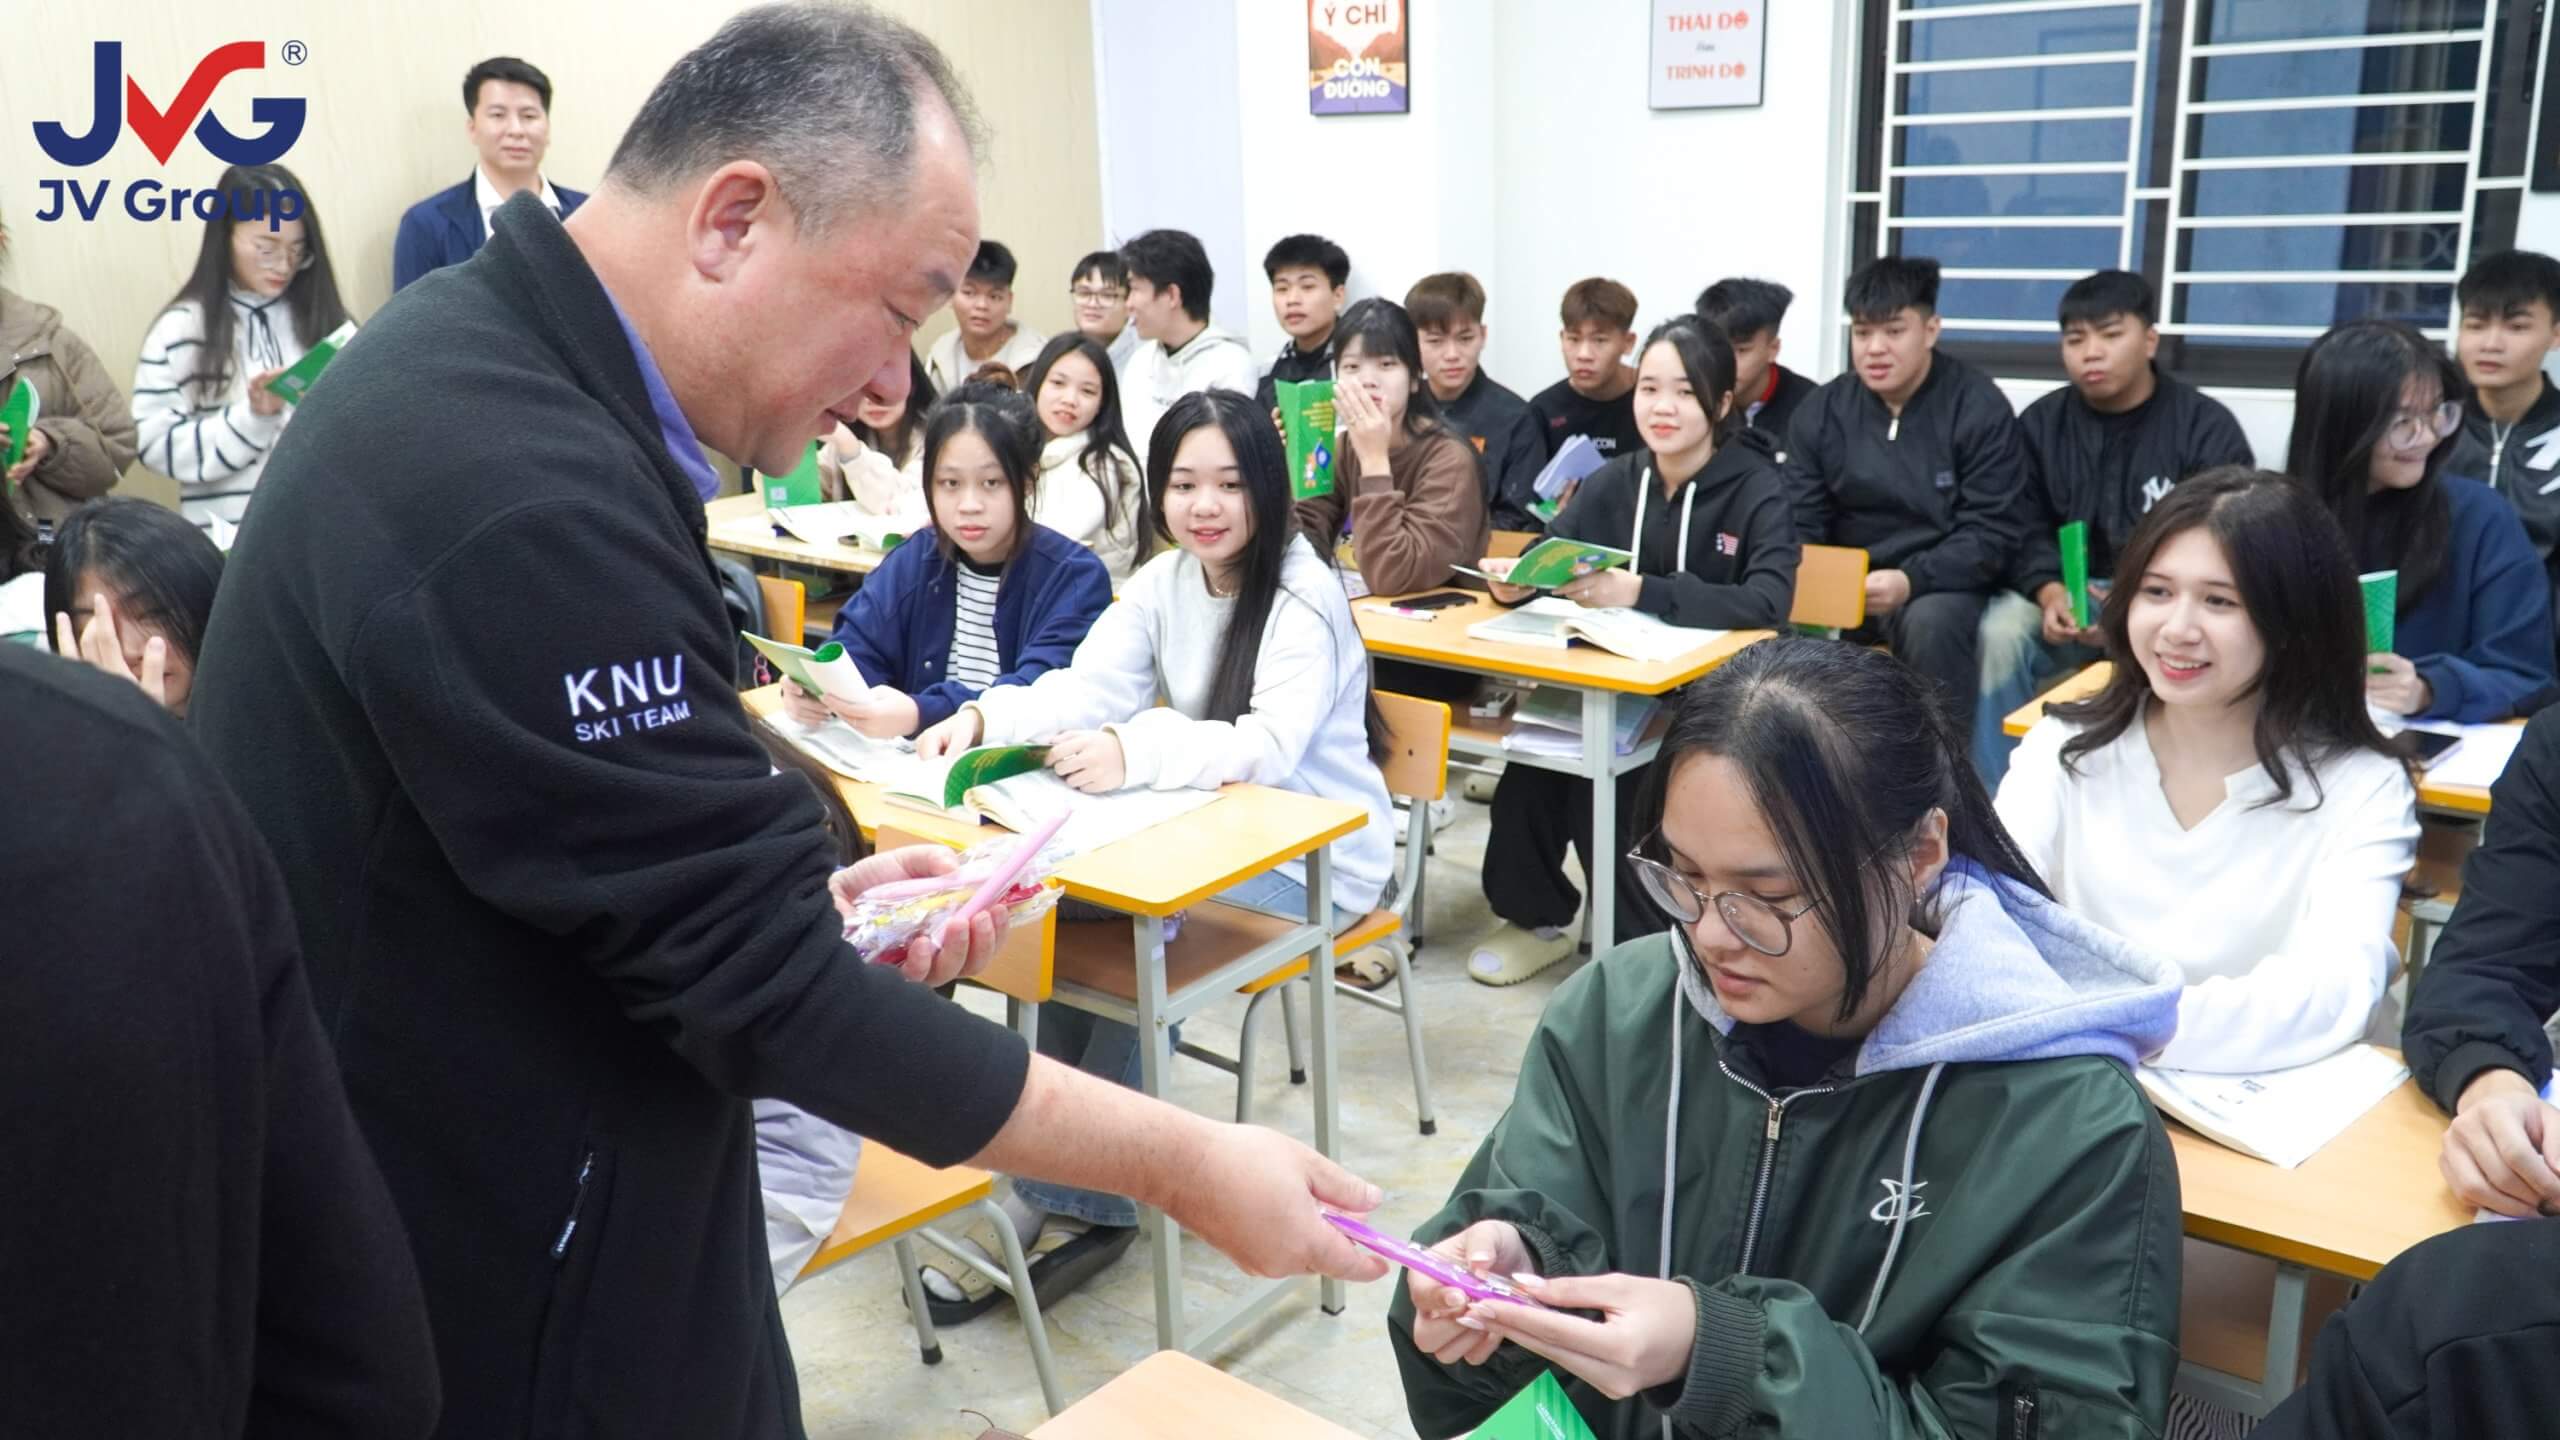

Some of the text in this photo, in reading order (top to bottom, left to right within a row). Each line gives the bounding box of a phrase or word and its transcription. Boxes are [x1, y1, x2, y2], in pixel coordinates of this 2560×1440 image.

[1333, 56, 1381, 78] CON
[564, 653, 683, 717] KNU
[574, 700, 692, 742] SKI TEAM
